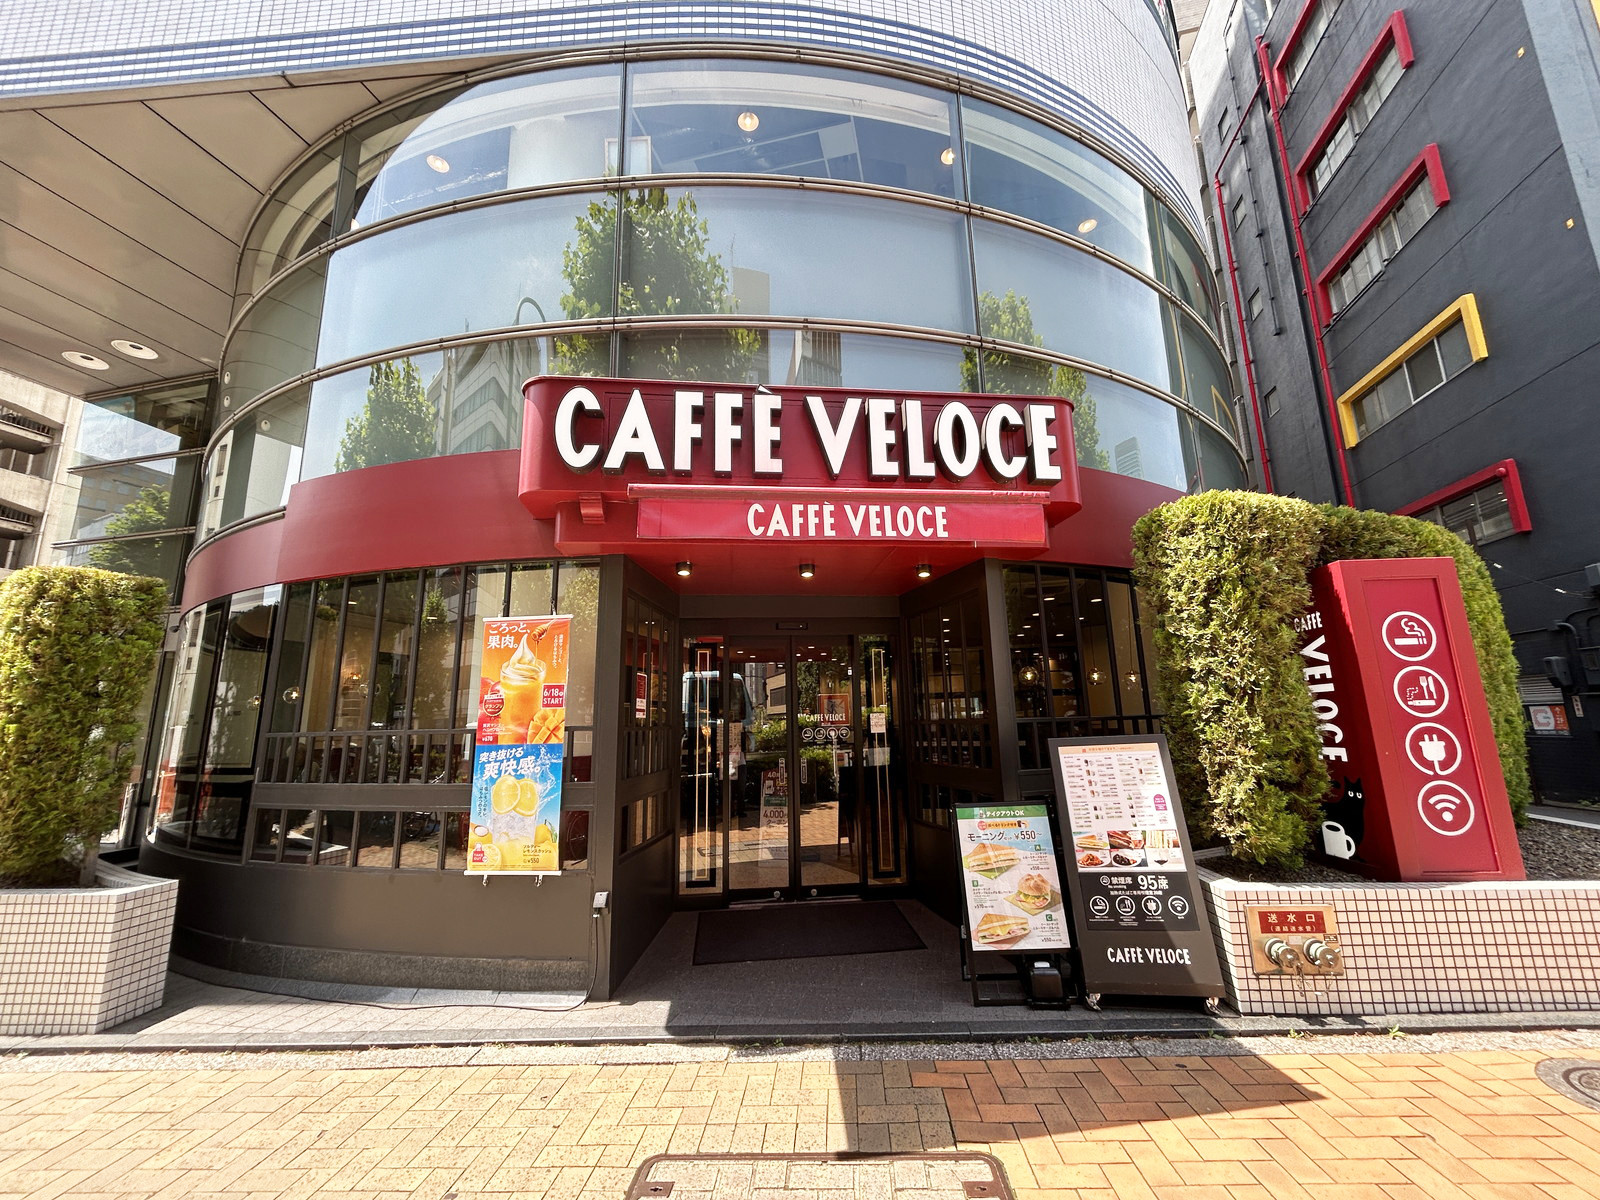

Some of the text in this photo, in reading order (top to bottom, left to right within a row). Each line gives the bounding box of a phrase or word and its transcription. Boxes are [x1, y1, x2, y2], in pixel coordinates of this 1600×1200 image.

[554, 384, 1062, 486] CAFFÈ VELOCE
[747, 501, 949, 539] CAFFÈ VELOCE
[489, 622, 530, 634] ごろっと、
[487, 635, 518, 649] 果肉。
[1300, 634, 1348, 762] VELOCE
[479, 747, 524, 763] 突き抜ける
[482, 756, 541, 780] 爽快感。
[986, 810, 1025, 818] テイクアウトOK
[967, 831, 1004, 842] モーニング
[1111, 876, 1133, 885] 禁煙席
[1268, 913, 1315, 923] 送水口
[1145, 948, 1191, 965] VELOCE
